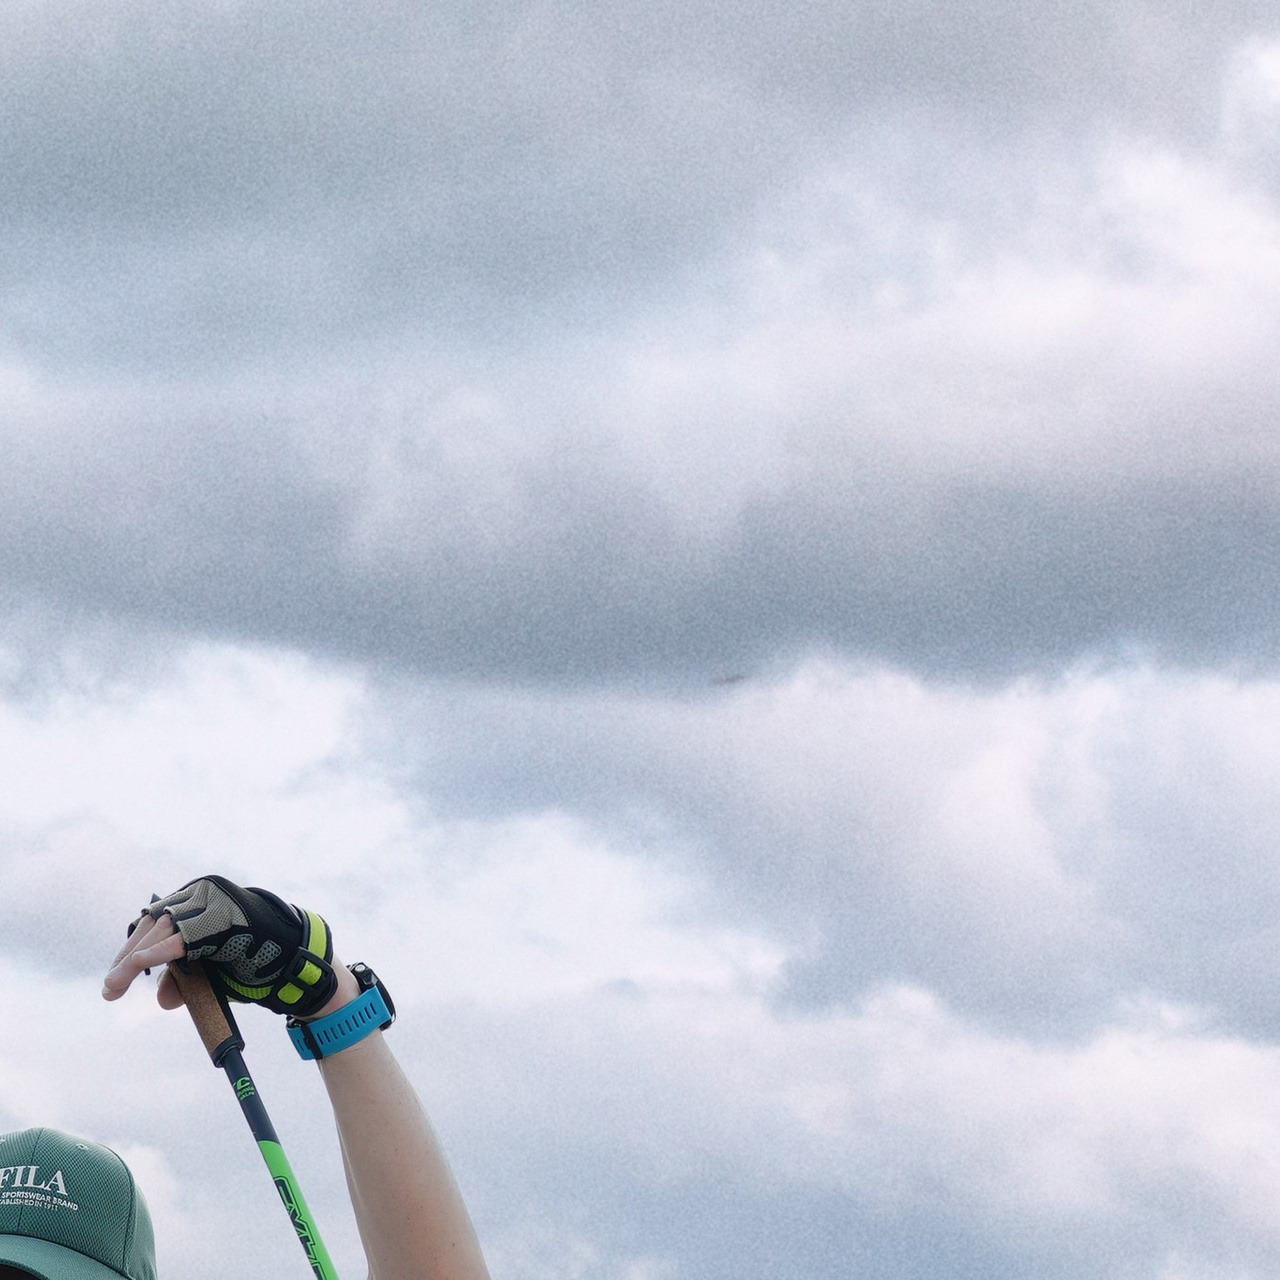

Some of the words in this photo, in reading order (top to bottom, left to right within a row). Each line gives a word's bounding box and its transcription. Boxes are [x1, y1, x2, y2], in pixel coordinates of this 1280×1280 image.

[1, 1191, 51, 1203] SPORTSWEAR
[52, 1197, 79, 1211] BRAND
[44, 1202, 58, 1211] 1911
